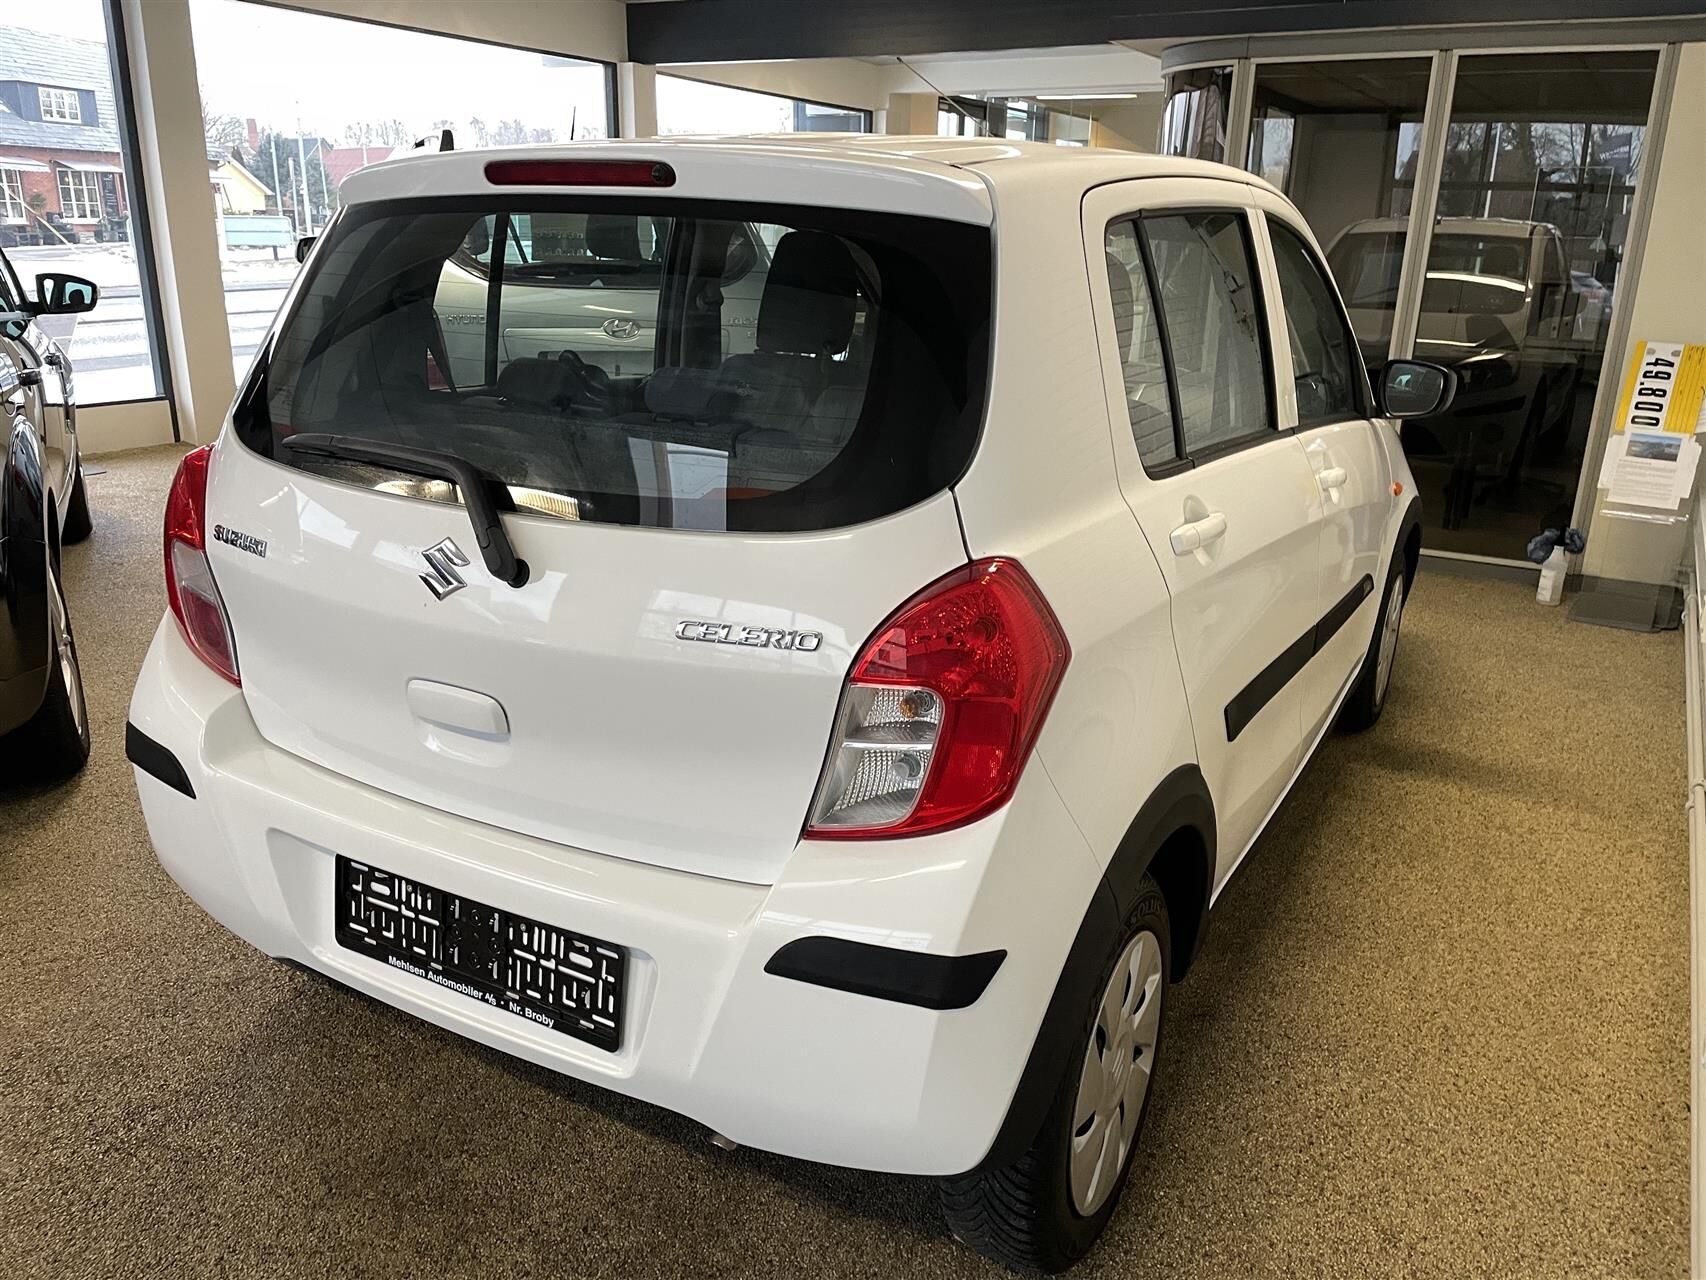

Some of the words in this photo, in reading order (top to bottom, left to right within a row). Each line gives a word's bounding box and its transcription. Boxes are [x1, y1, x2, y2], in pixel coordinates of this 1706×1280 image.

[1630, 357, 1675, 427] 49.800
[213, 524, 267, 558] SUZUKI
[675, 620, 823, 652] CELERIO
[388, 955, 426, 977] Mehlsen
[427, 970, 483, 999] Automobiler
[509, 1001, 523, 1015] Nr.
[525, 1007, 555, 1028] Broby
